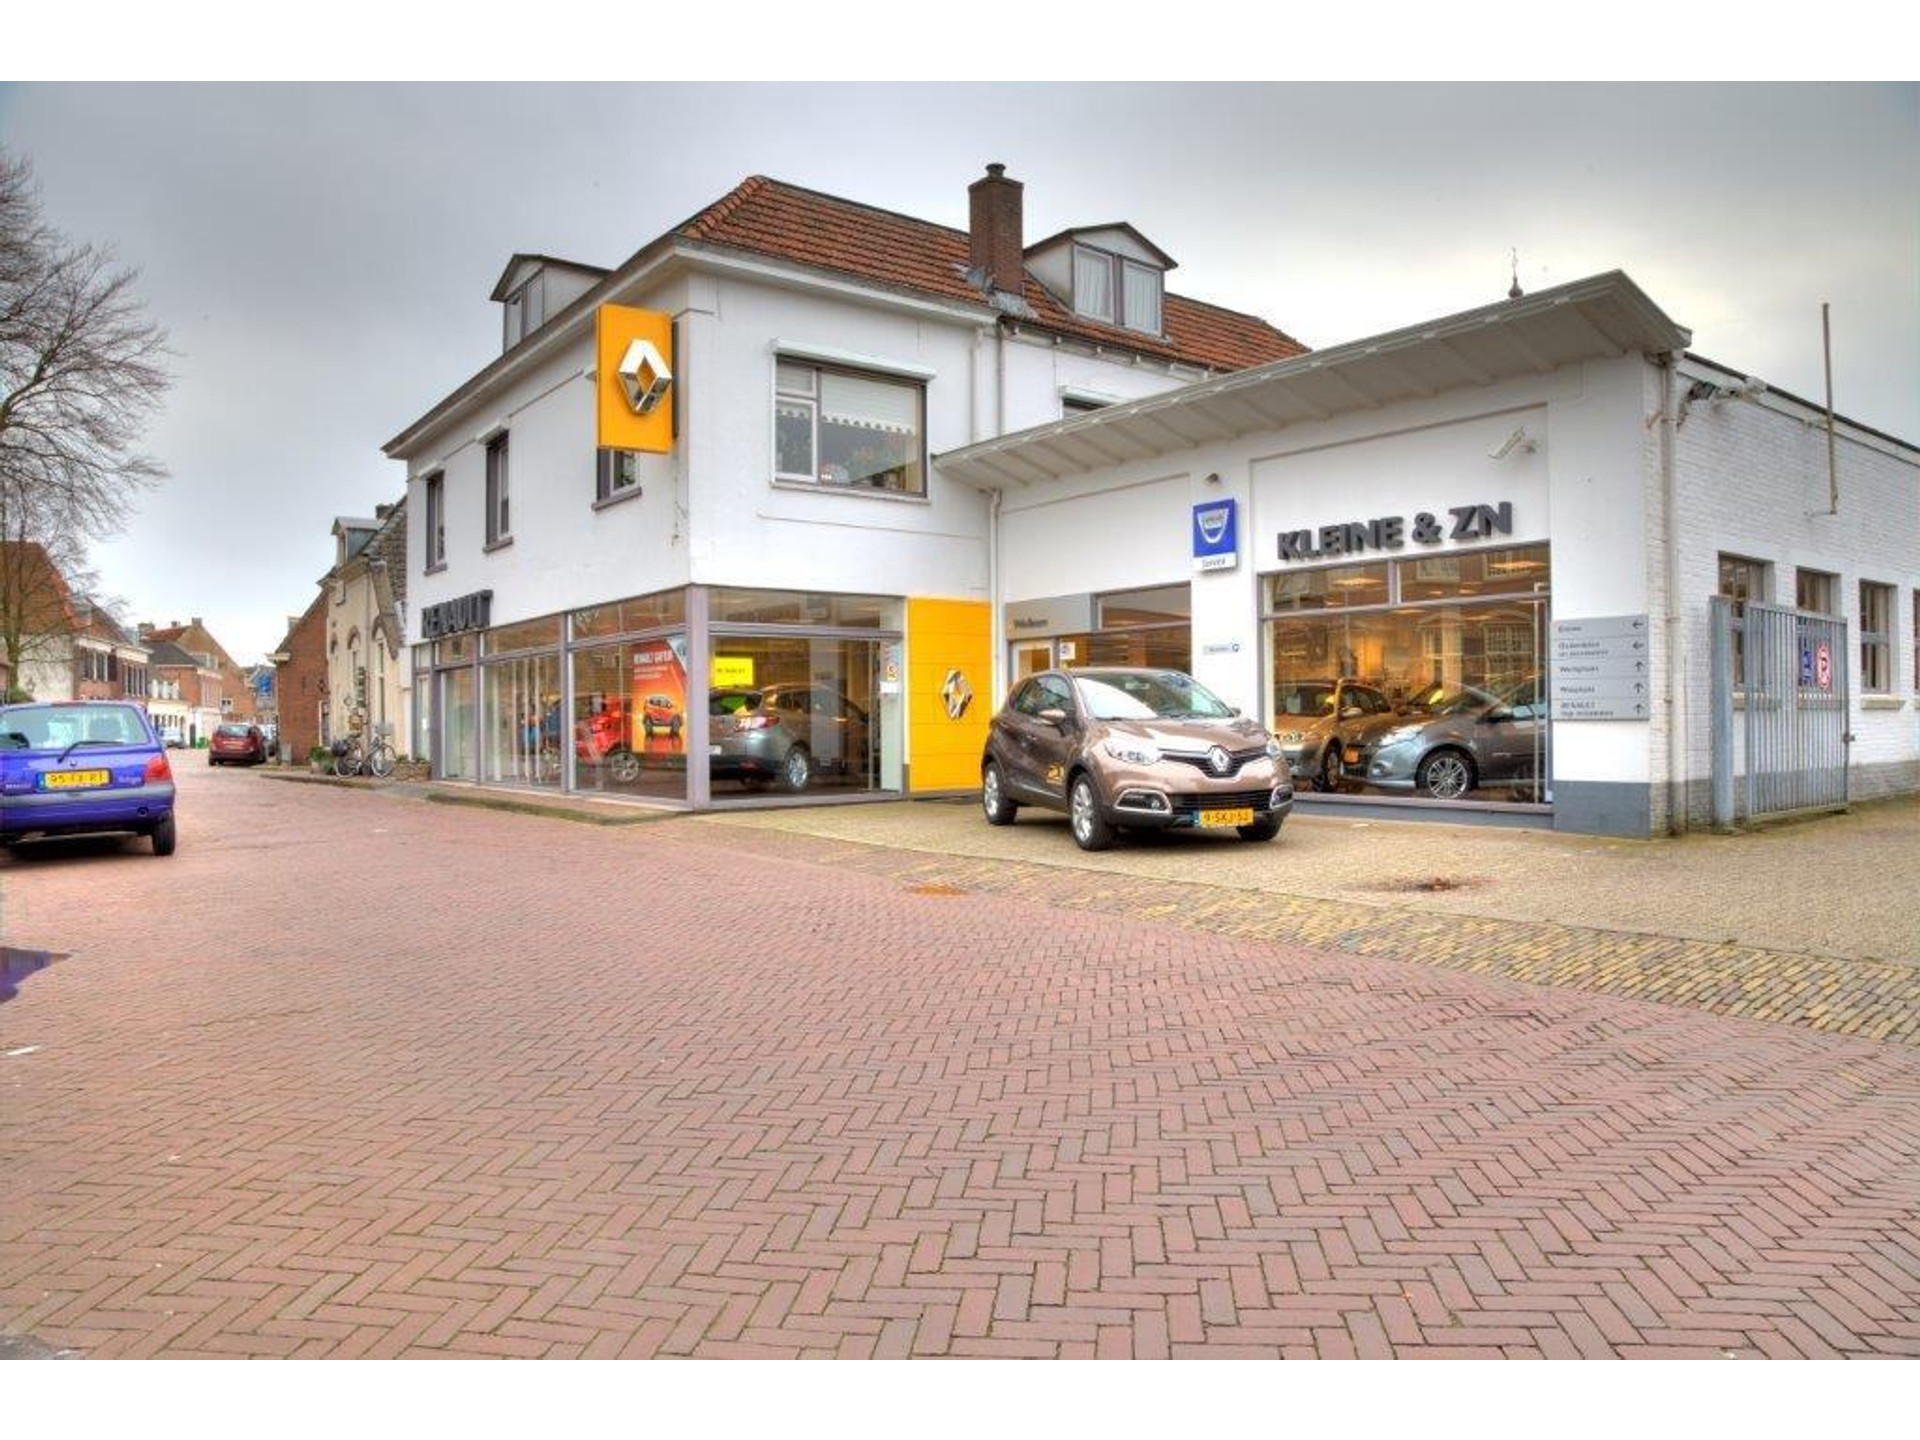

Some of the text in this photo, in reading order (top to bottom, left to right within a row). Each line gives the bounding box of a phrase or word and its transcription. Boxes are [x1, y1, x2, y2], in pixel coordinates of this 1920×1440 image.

[1277, 501, 1512, 560] KLEINE & ZN
